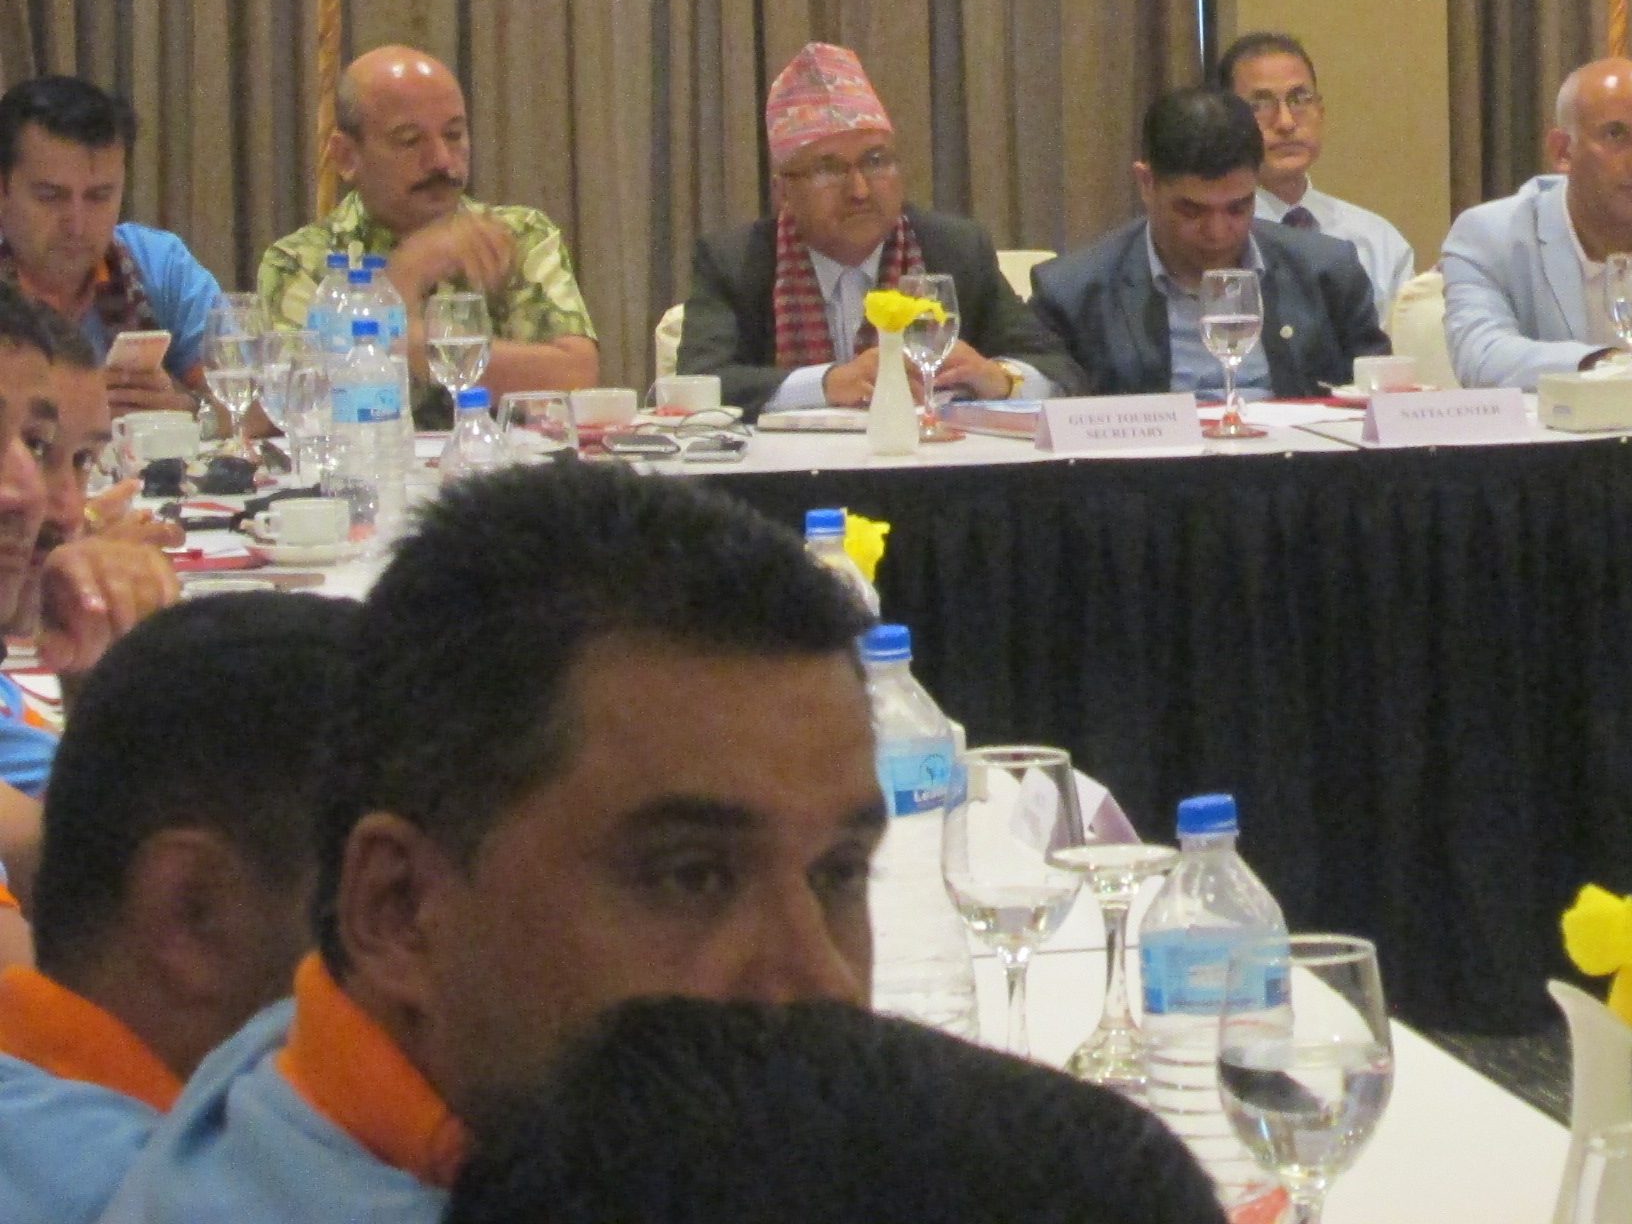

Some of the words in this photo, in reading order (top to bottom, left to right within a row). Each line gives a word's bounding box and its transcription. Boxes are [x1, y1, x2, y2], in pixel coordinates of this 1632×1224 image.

[1446, 404, 1501, 418] CENTER
[1068, 415, 1111, 426] GUEST
[1115, 411, 1177, 424] TOURISM
[1086, 426, 1164, 439] SECRETARY
